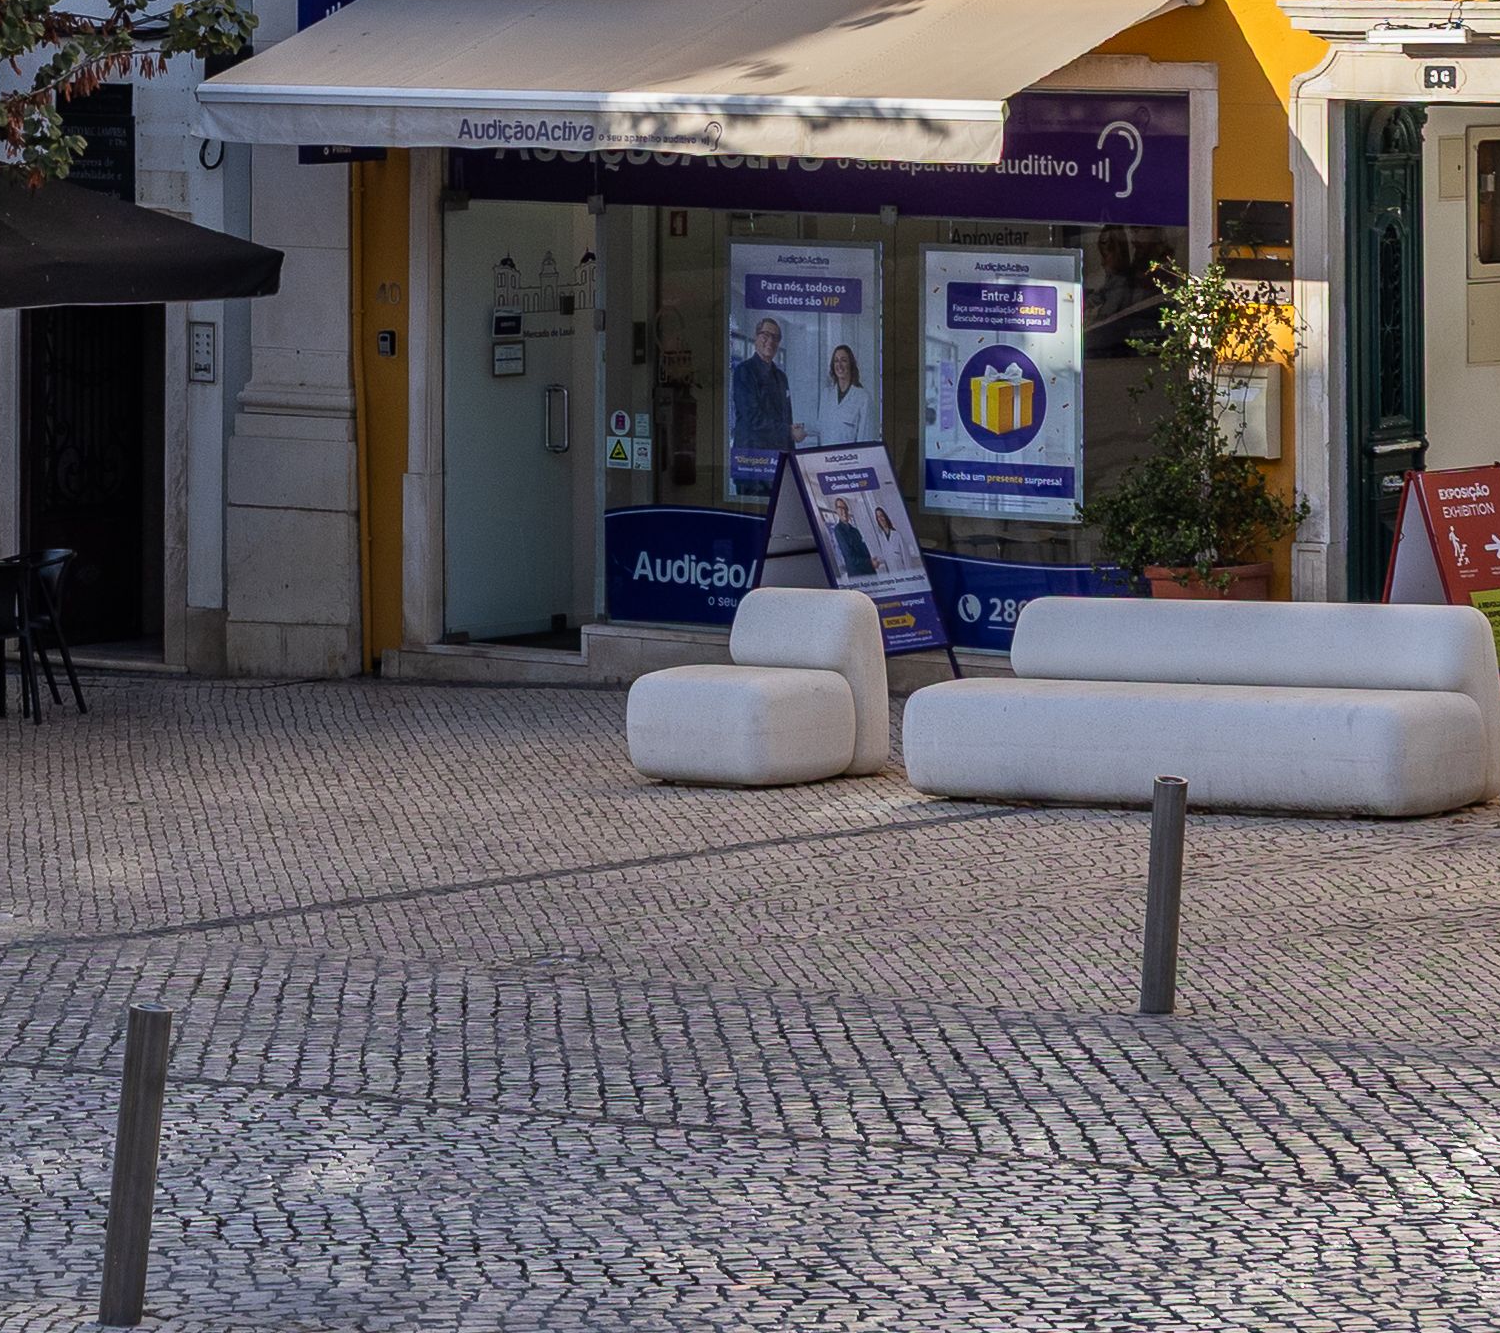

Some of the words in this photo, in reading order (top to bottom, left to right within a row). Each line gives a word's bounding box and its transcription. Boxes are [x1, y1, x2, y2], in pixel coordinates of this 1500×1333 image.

[458, 118, 594, 143] AudiçãoActiva
[624, 133, 662, 145] aparelho
[662, 135, 696, 144] auditivo
[995, 154, 1079, 177] auditivo
[761, 280, 782, 291] Para
[784, 281, 804, 292] nós,
[806, 283, 833, 293] todos
[835, 285, 846, 293] os
[767, 294, 803, 306] clientes
[805, 297, 822, 306] são
[823, 296, 840, 307] VIP
[981, 289, 1009, 301] Entre
[1011, 290, 1023, 302] Já
[952, 304, 968, 313] Faça
[953, 314, 984, 323] descubra
[990, 317, 1003, 325] que
[1004, 317, 1025, 325] temos
[1025, 319, 1042, 327] para
[942, 470, 971, 481] Receba
[972, 473, 985, 481] um
[986, 474, 1024, 484] presente
[1024, 477, 1063, 487] surpresa!
[1438, 482, 1490, 501] EXPOSIÇÃO
[1442, 502, 1496, 518] EXHIBITION
[708, 596, 715, 606] o
[718, 596, 737, 607] seu
